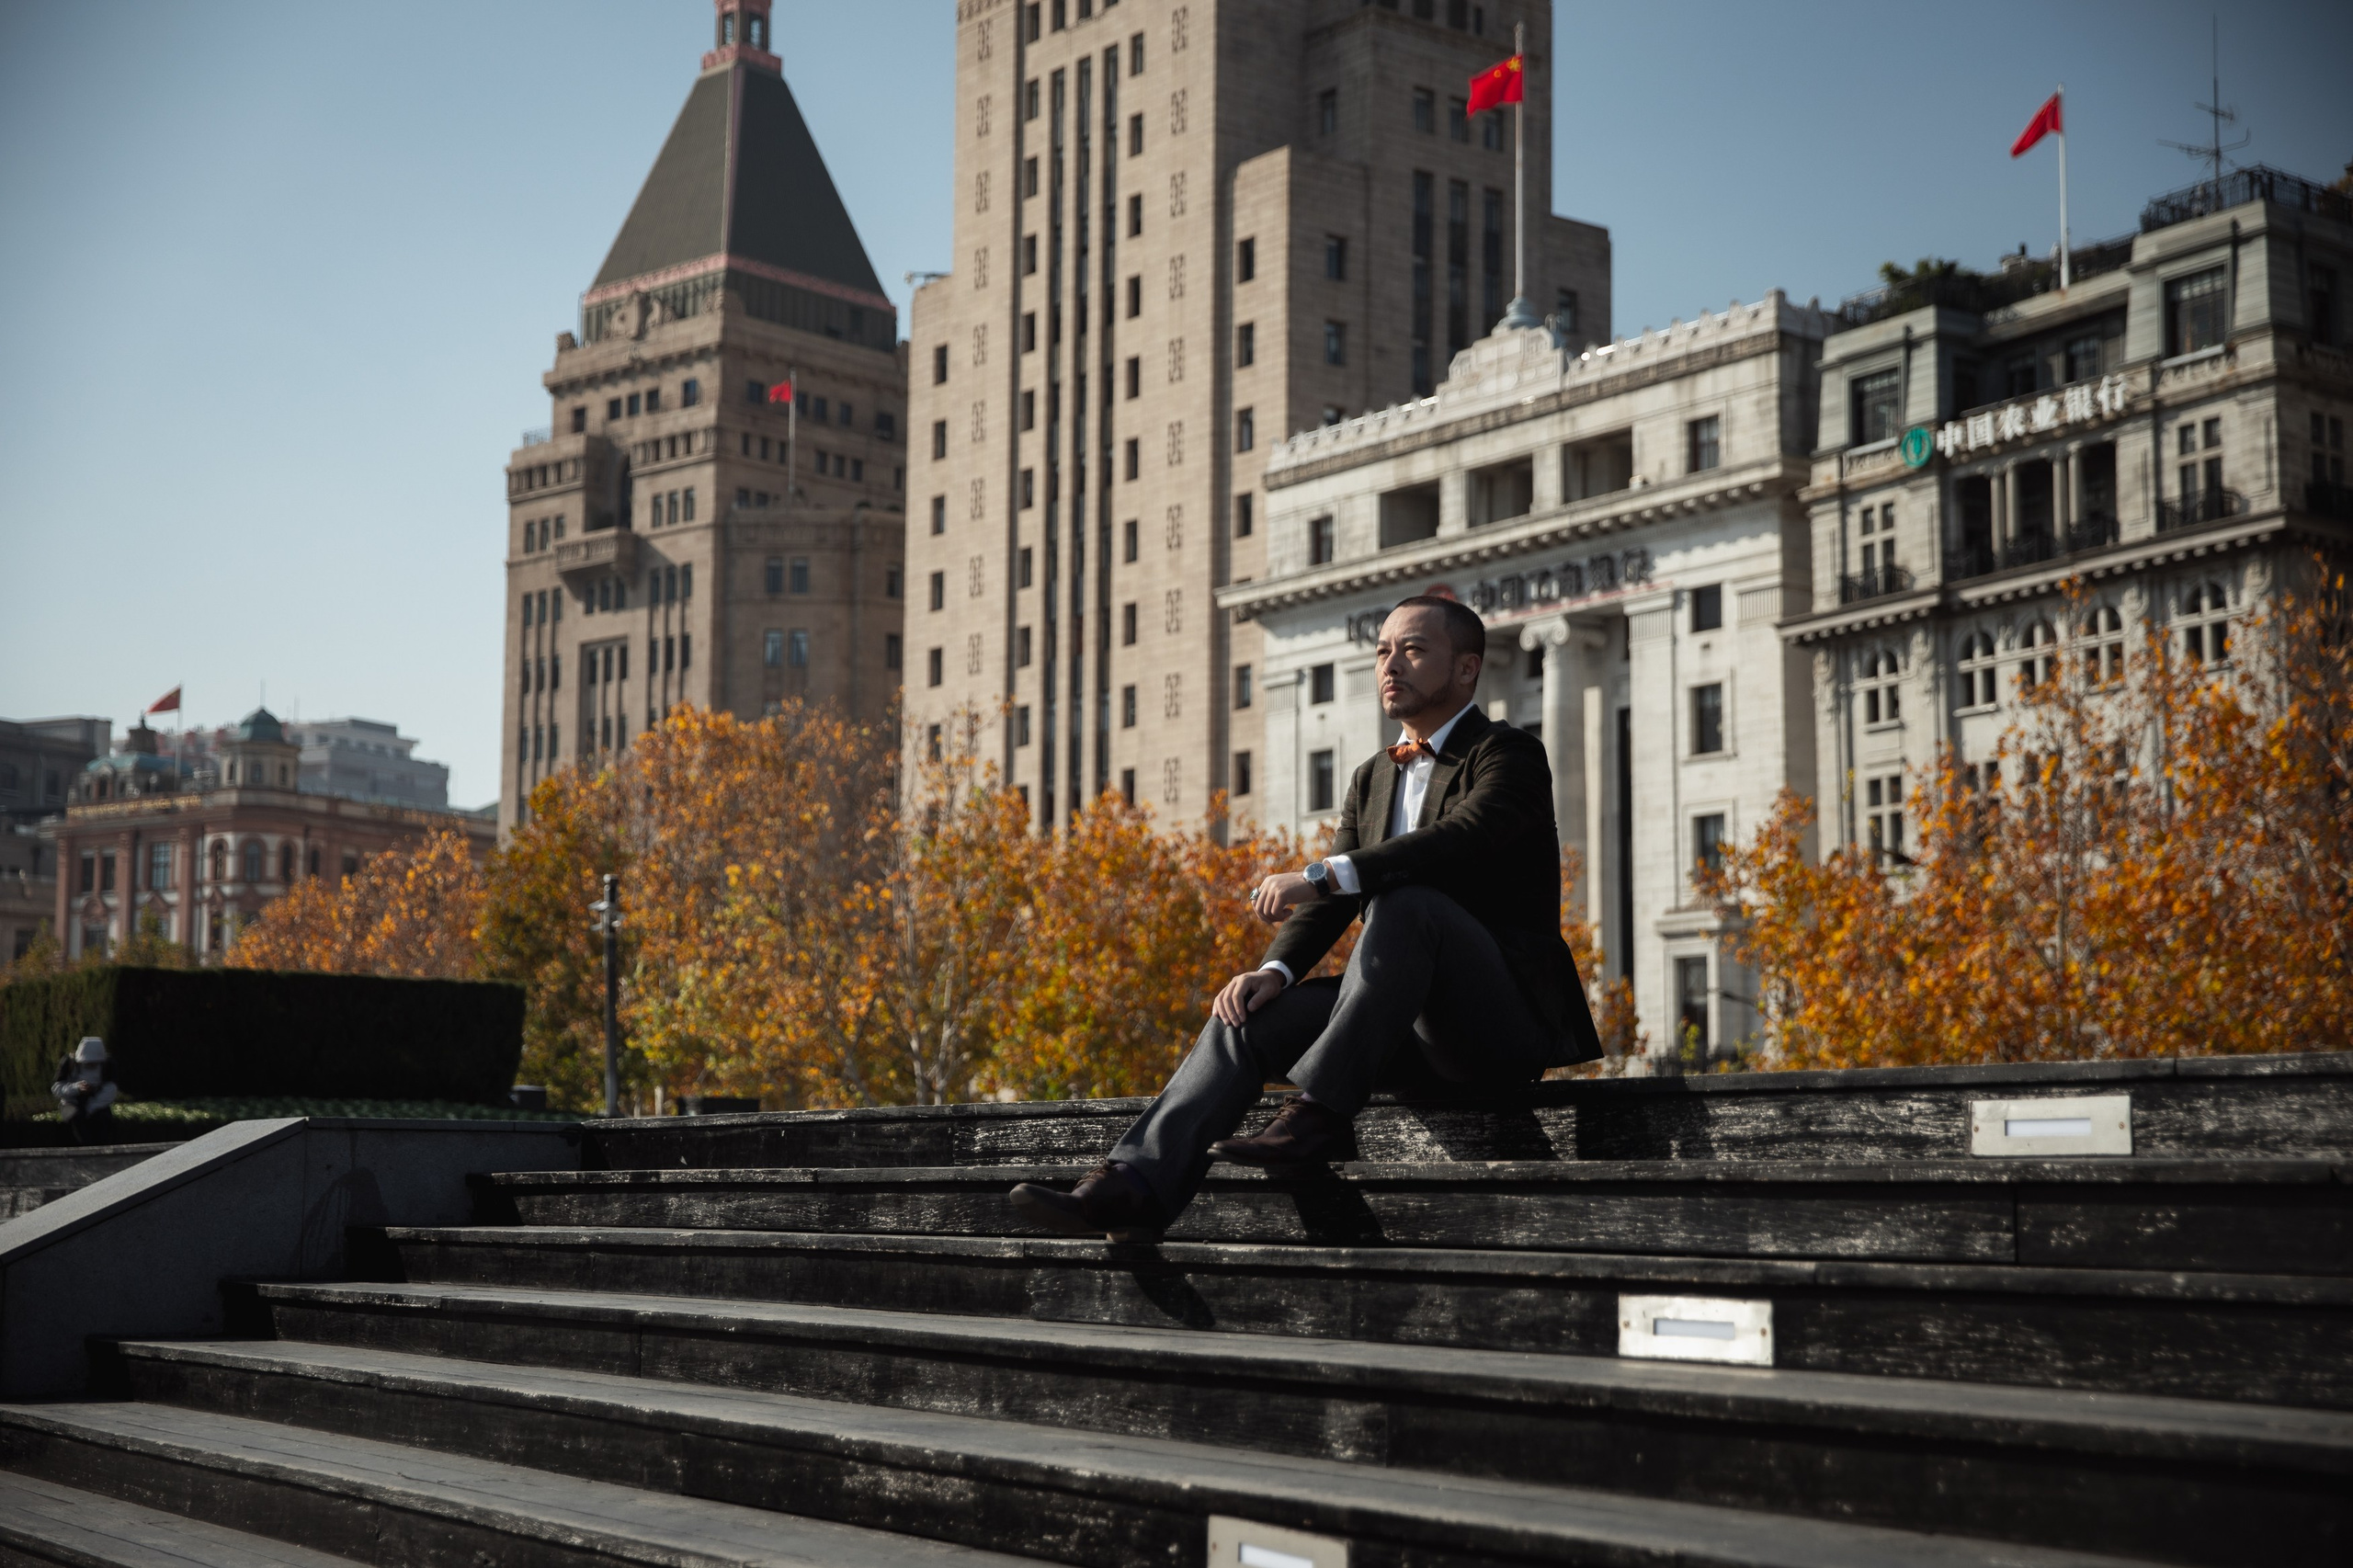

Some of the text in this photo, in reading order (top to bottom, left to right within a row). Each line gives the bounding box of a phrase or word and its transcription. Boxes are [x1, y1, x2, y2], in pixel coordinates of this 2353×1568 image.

[1937, 374, 2128, 458] 中国农业银行
